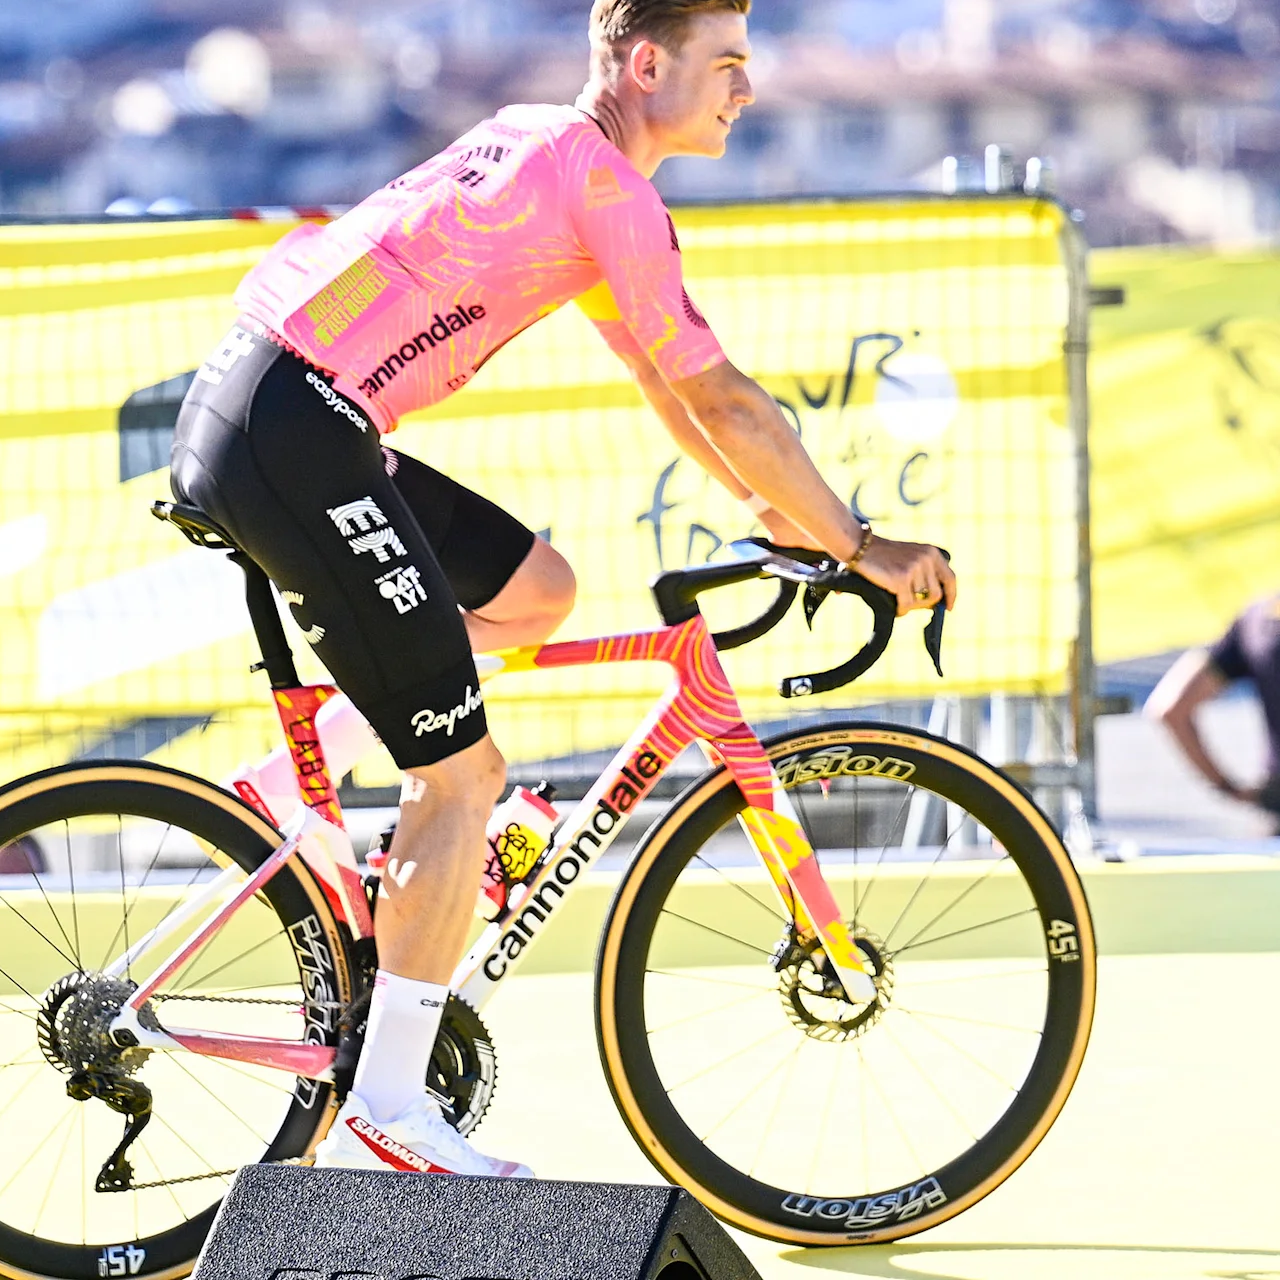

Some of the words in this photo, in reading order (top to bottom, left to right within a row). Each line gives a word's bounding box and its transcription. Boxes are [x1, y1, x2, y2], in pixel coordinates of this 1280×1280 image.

[305, 371, 368, 433] easypost
[482, 751, 661, 983] cannondale
[1046, 919, 1079, 956] 45
[352, 1116, 432, 1173] SALOMON
[107, 1244, 146, 1276] 45
